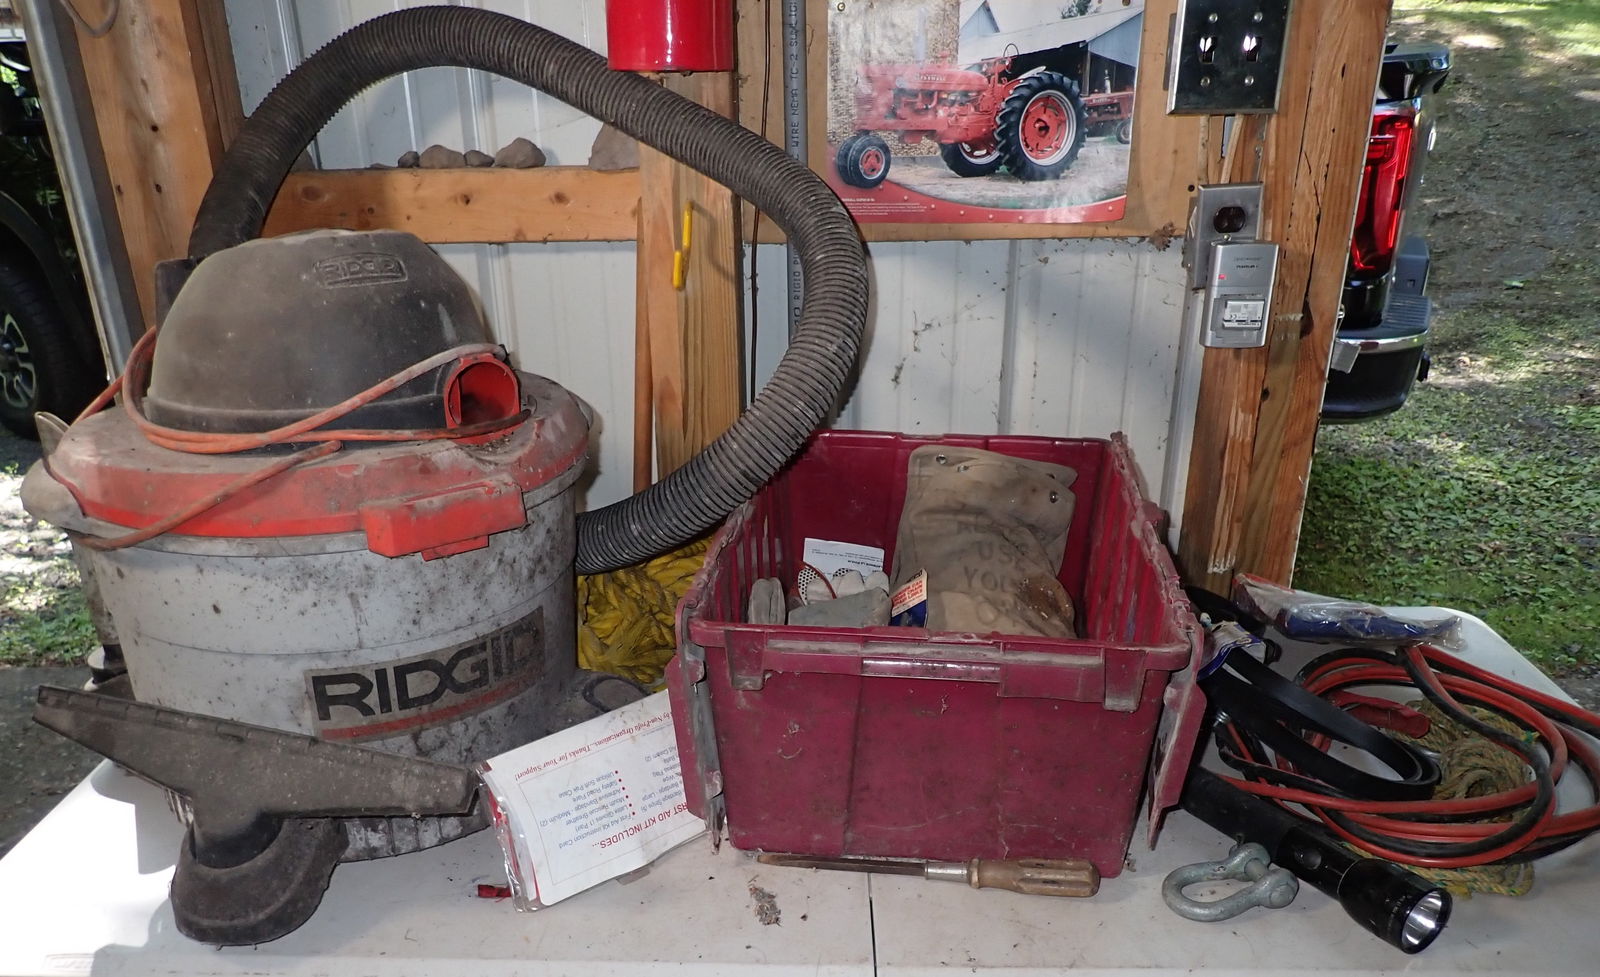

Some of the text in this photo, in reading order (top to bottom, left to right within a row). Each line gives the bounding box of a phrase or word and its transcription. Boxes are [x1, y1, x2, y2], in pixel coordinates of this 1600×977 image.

[790, 53, 798, 80] TC-2
[790, 88, 798, 116] NEMA
[791, 122, 799, 147] WIRE
[542, 758, 557, 769] Your
[558, 789, 572, 799] Case
[586, 787, 600, 796] Road
[671, 802, 688, 814] RST
[657, 809, 671, 821] AID
[642, 817, 656, 828] KIT
[558, 839, 573, 849] Card
